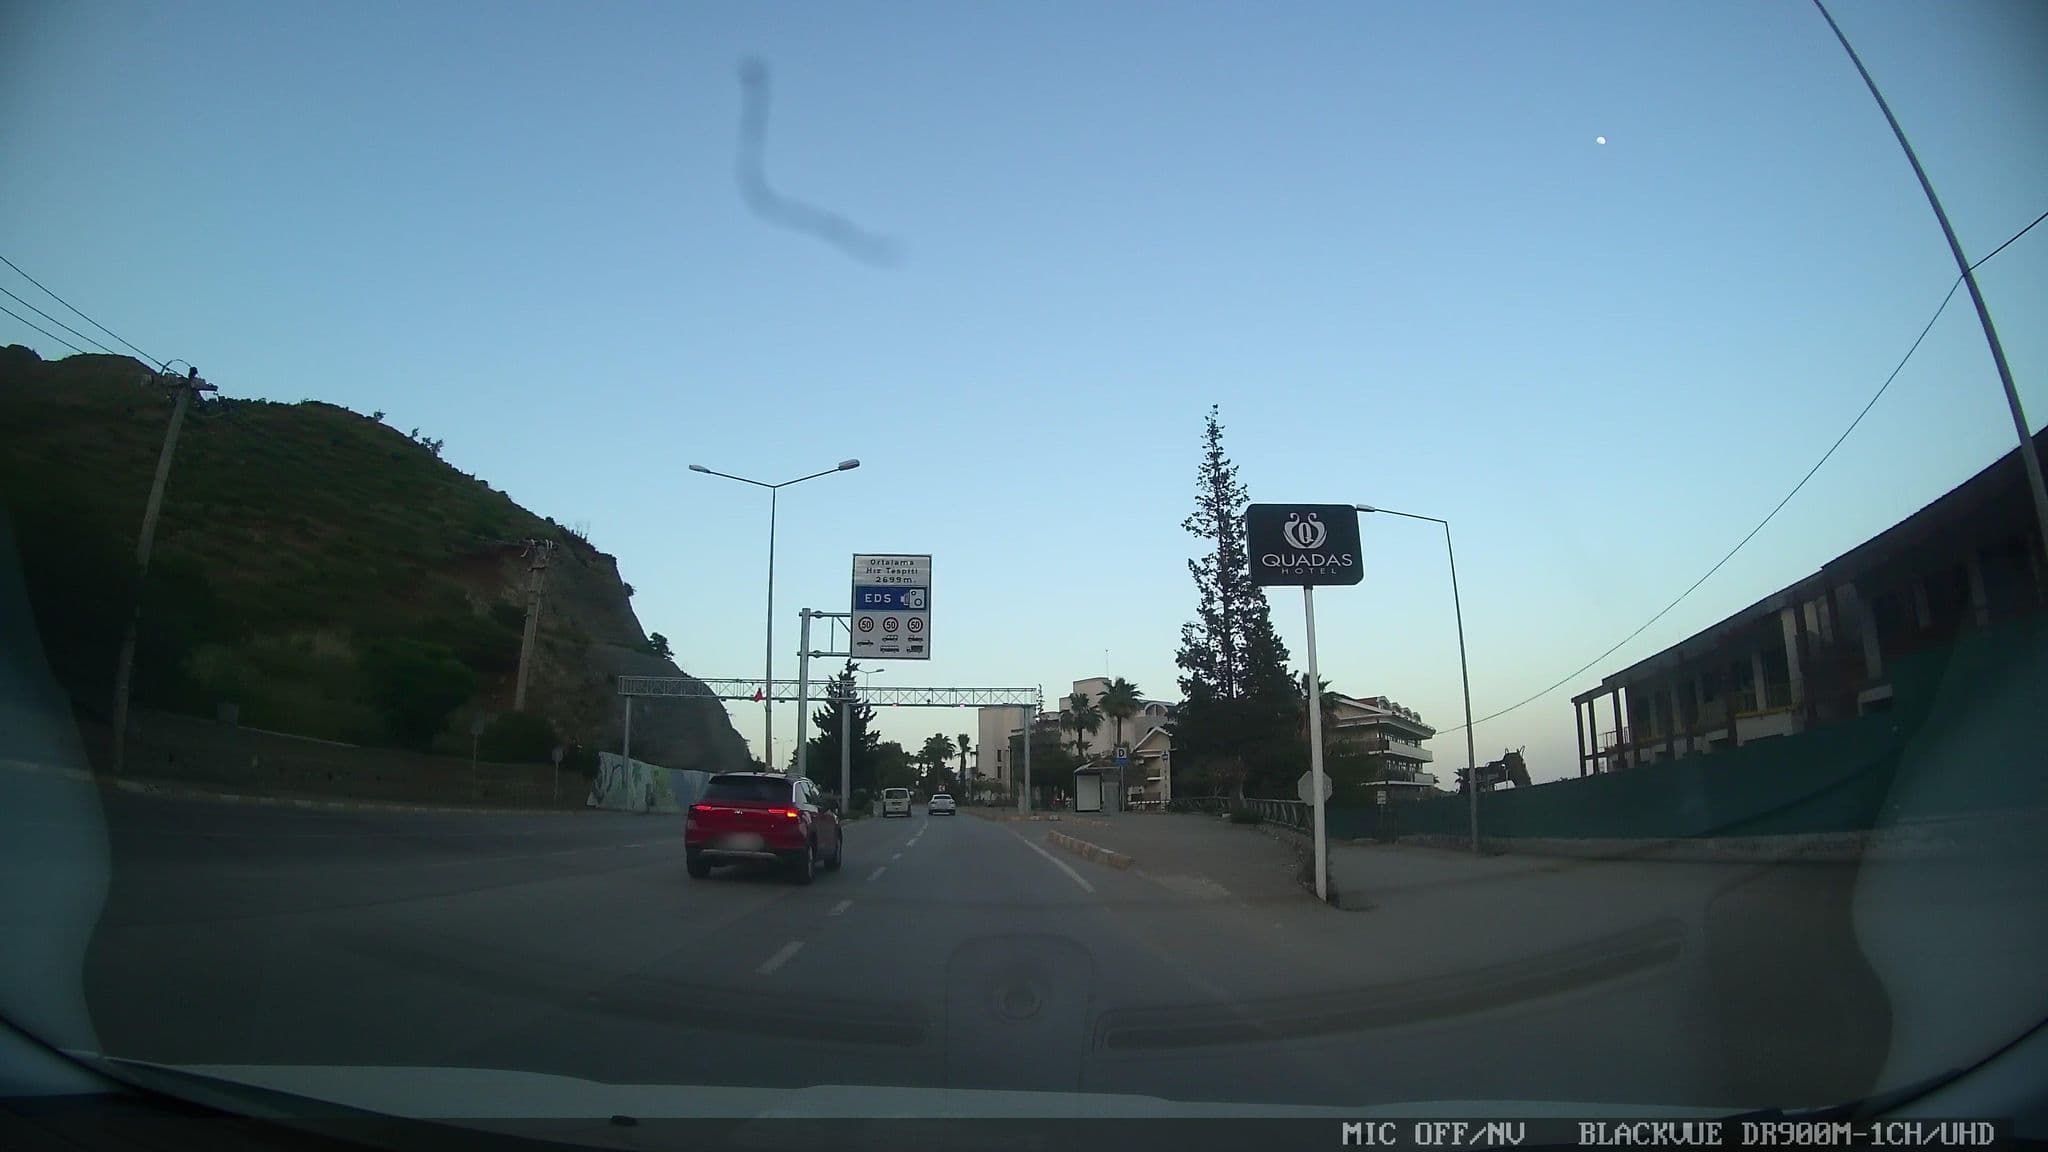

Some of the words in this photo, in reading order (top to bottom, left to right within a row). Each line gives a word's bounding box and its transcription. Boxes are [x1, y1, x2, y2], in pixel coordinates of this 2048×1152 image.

[1261, 553, 1353, 567] QUADAS
[1281, 567, 1337, 575] HOTEL
[865, 593, 892, 603] EDS
[862, 620, 871, 629] 50
[886, 620, 896, 629] 50
[911, 620, 920, 629] 50
